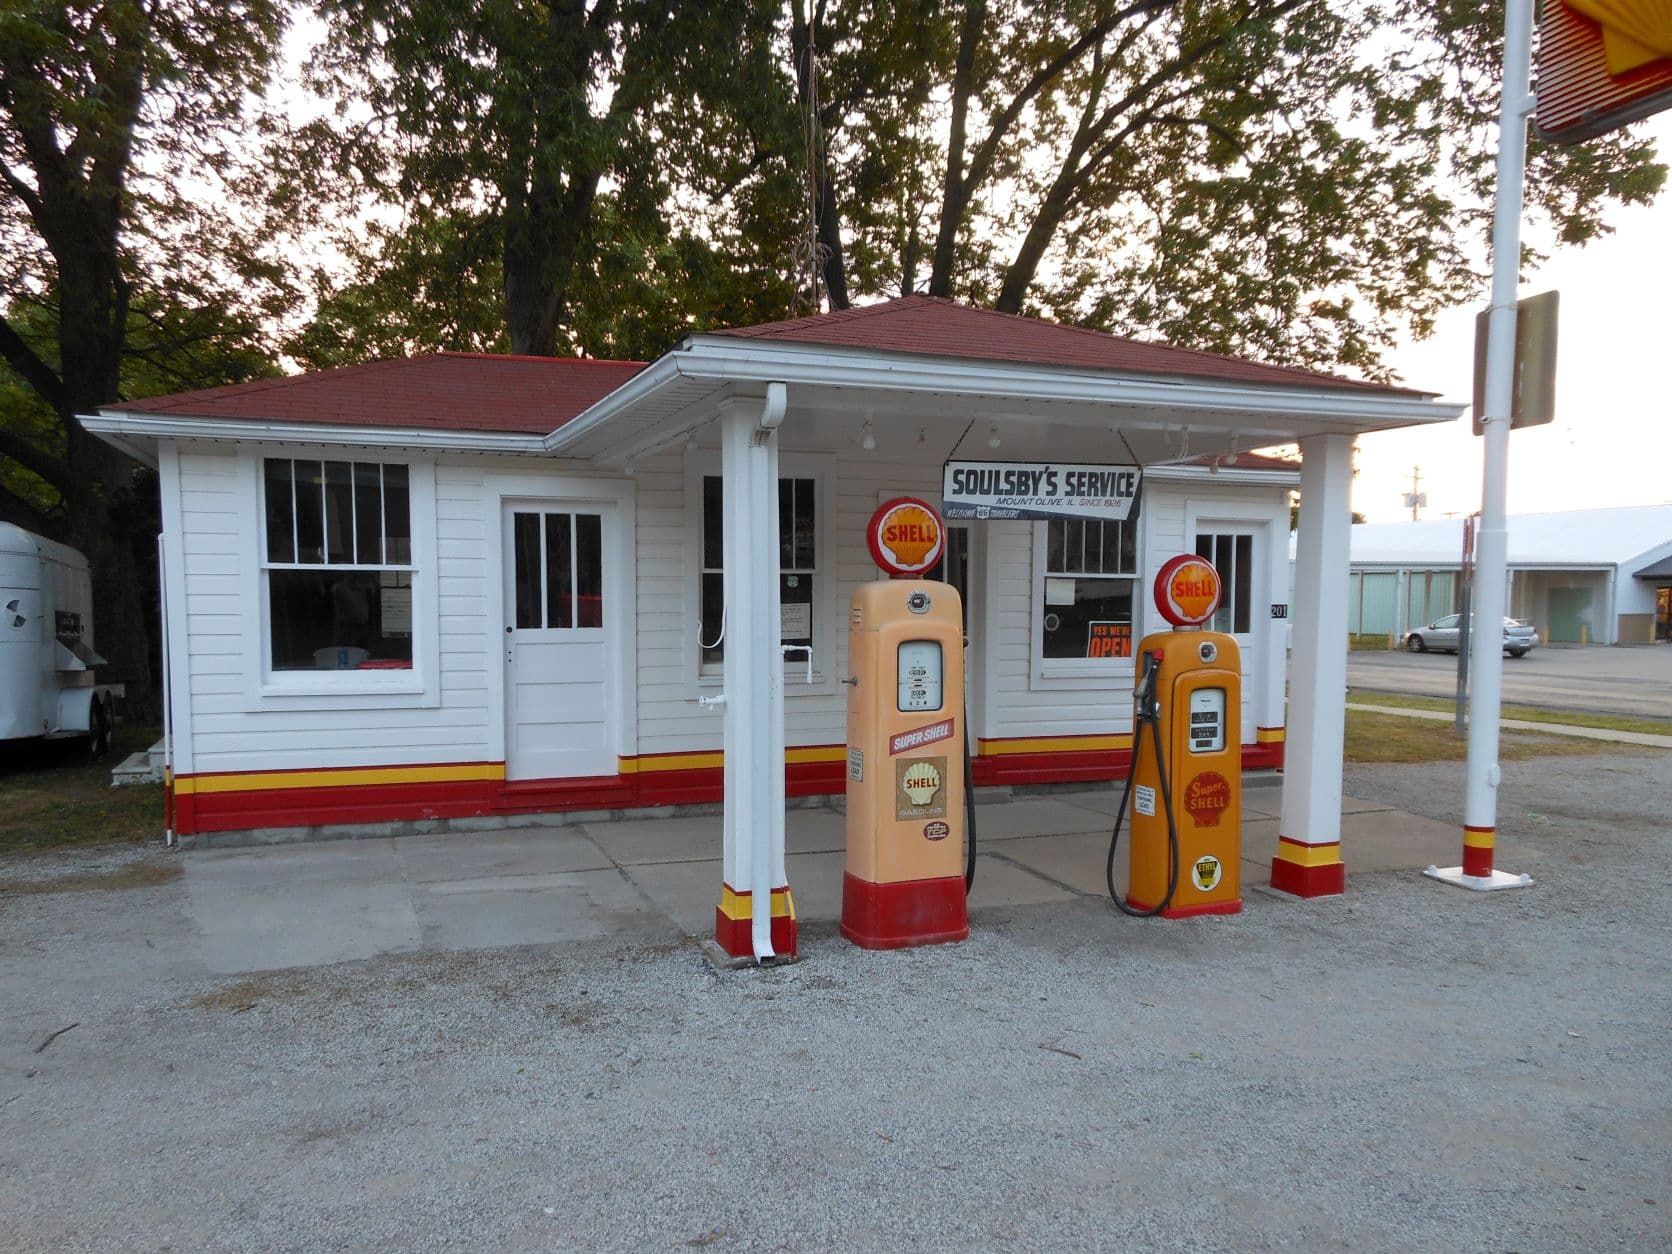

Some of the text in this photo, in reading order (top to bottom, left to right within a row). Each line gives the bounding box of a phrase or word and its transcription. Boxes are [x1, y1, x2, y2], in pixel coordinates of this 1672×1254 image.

[952, 466, 1135, 498] SOULSBY'S SERVICE
[996, 497, 1034, 506] MOUNT
[1078, 499, 1103, 508] SINCE
[1103, 500, 1121, 508] 1926
[886, 524, 935, 543] SHELL
[1175, 580, 1213, 598] SHELL
[1271, 606, 1286, 617] 201
[1093, 626, 1107, 636] YES
[1090, 638, 1132, 658] OPEN
[906, 778, 937, 789] SHELL
[1190, 796, 1225, 810] SHELL
[900, 807, 944, 817] GASOLINE
[927, 828, 947, 836] TCP
